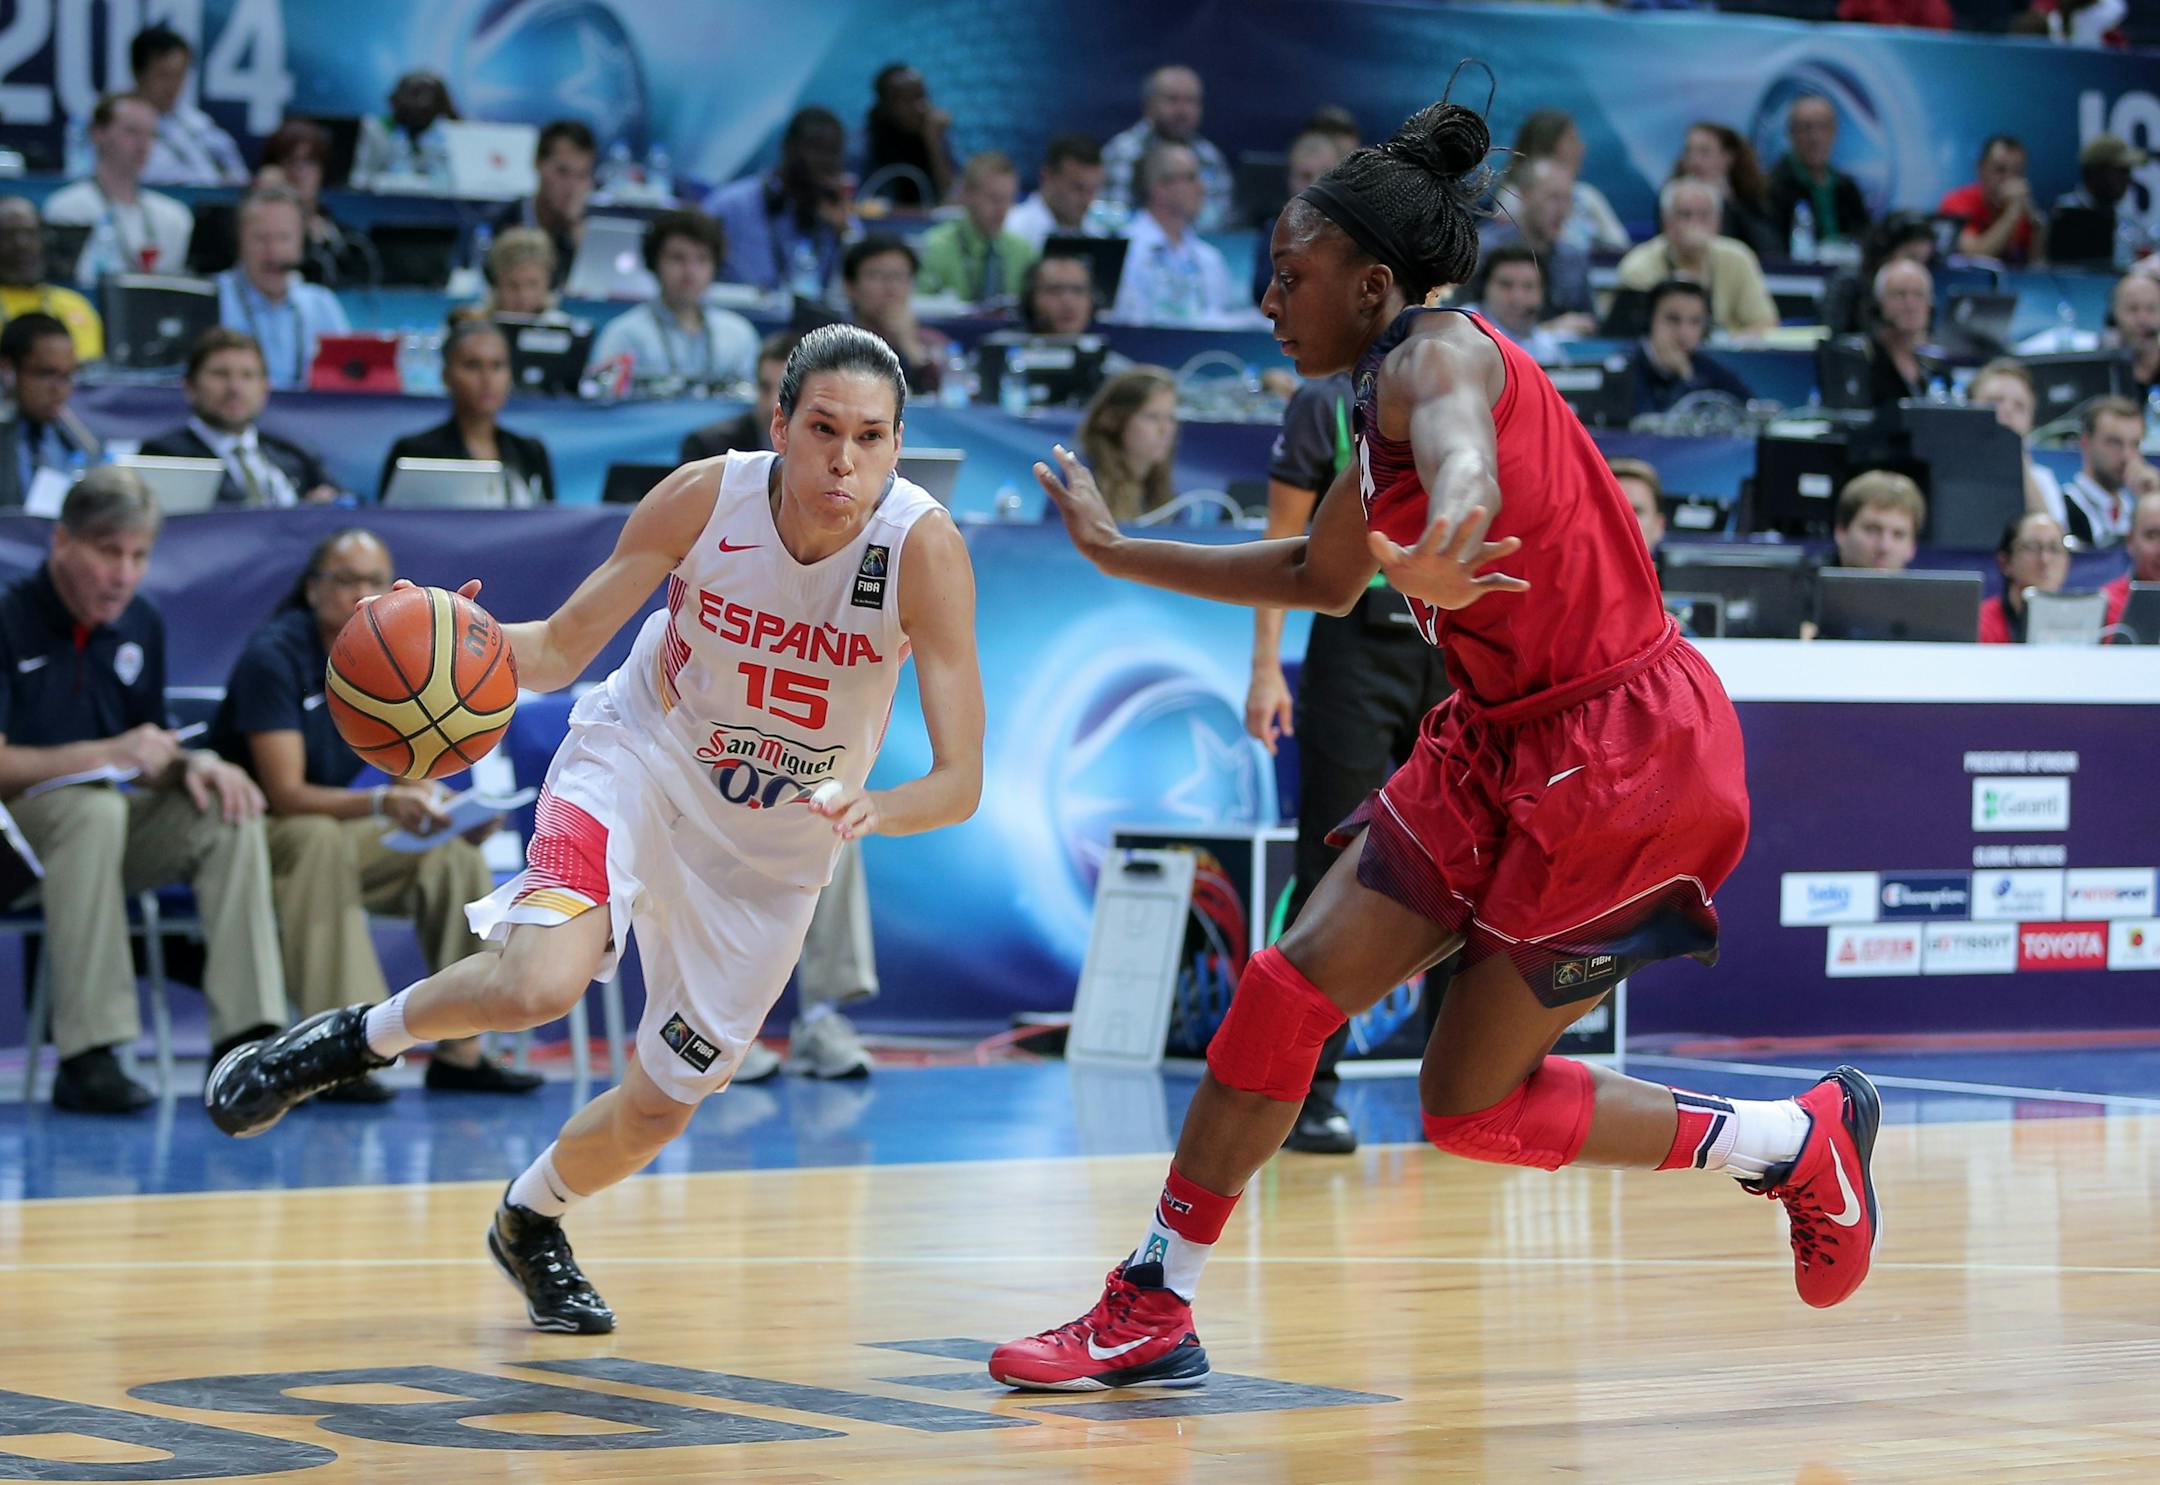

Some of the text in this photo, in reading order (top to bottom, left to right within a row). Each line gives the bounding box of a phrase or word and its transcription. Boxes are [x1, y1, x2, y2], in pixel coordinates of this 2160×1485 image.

[857, 580, 880, 593] FIBA
[698, 587, 883, 667] ESPAÑA
[738, 661, 830, 731] 15
[2021, 931, 2105, 960] TOYOTA
[692, 1040, 716, 1059] FIBA
